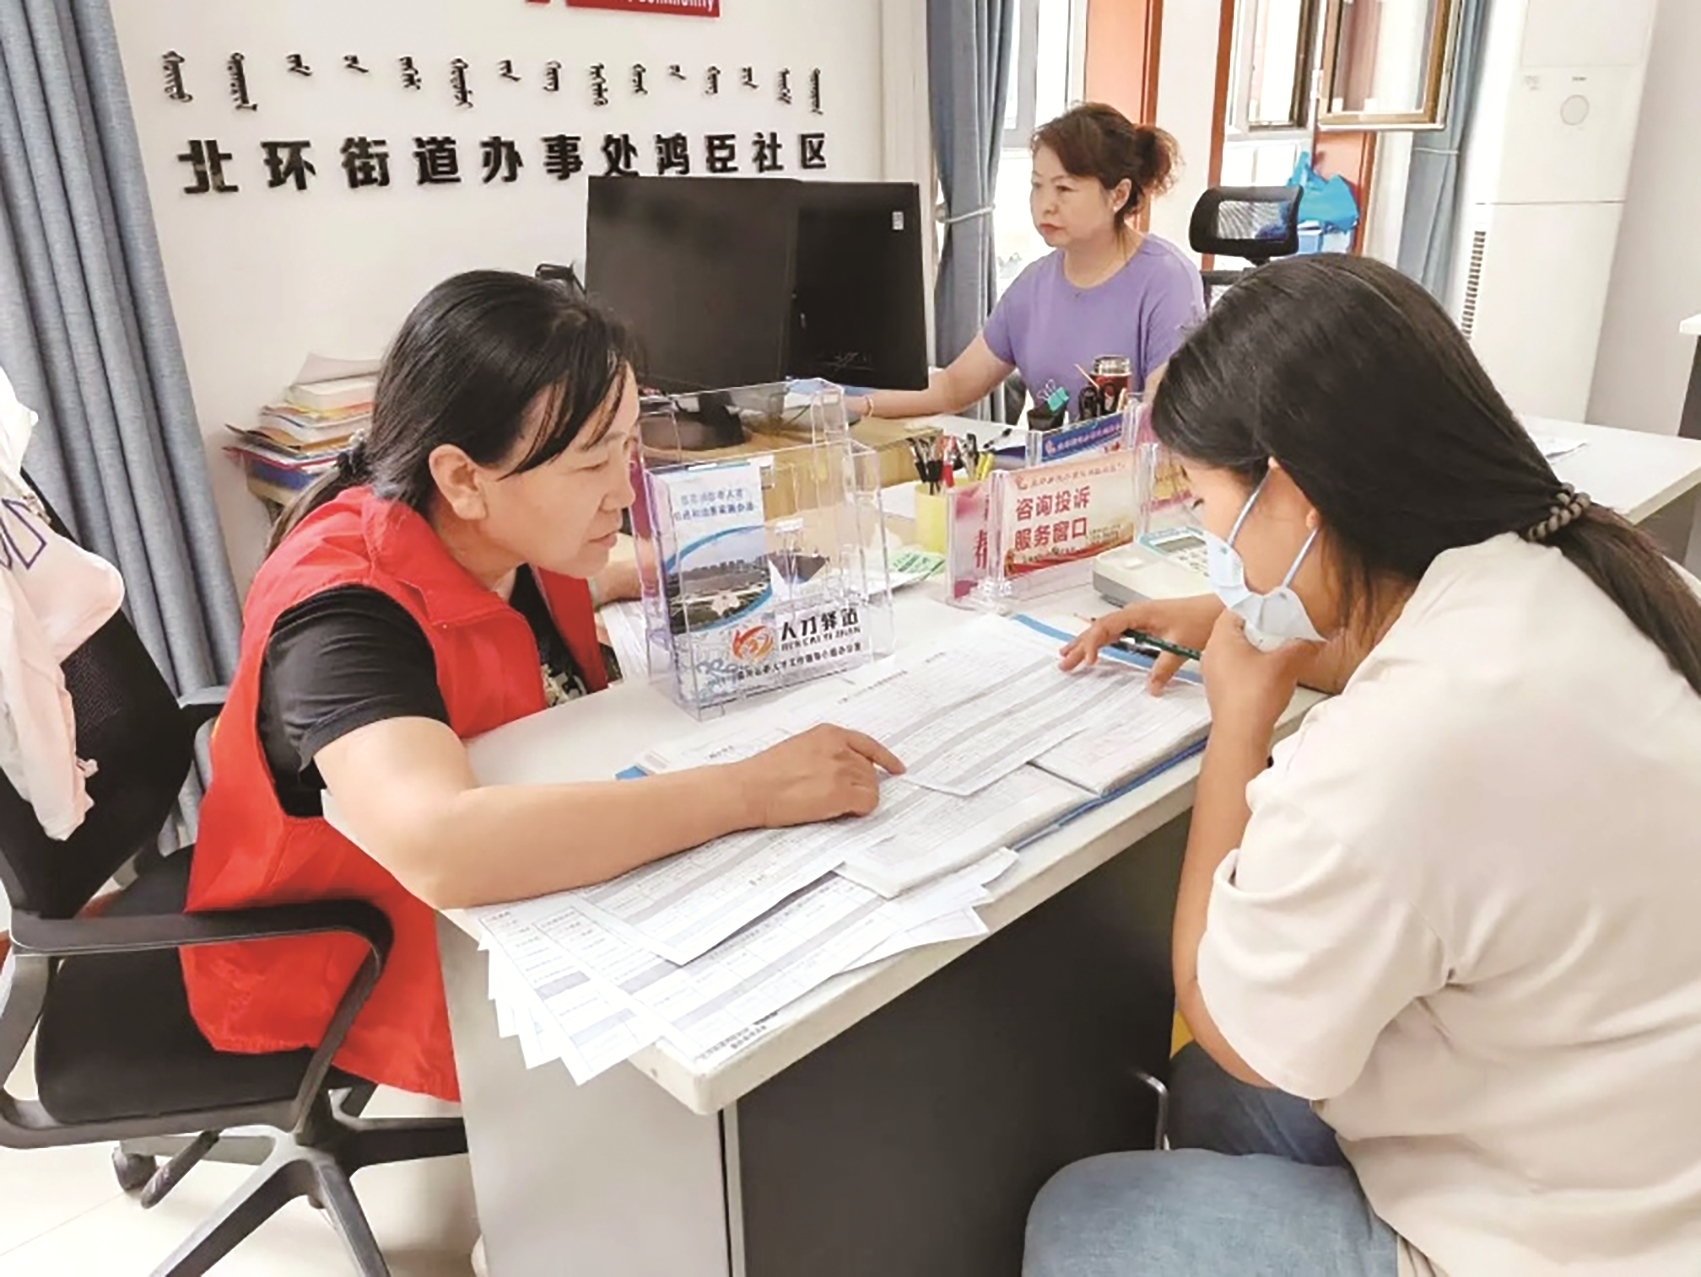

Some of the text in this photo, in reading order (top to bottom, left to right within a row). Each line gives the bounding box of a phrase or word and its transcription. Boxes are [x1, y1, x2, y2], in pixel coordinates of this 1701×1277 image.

[177, 131, 827, 194] 北环街道办事处鸿臣社区
[1015, 486, 1091, 522] 咨询投诉
[1014, 517, 1088, 552] 服务窗口
